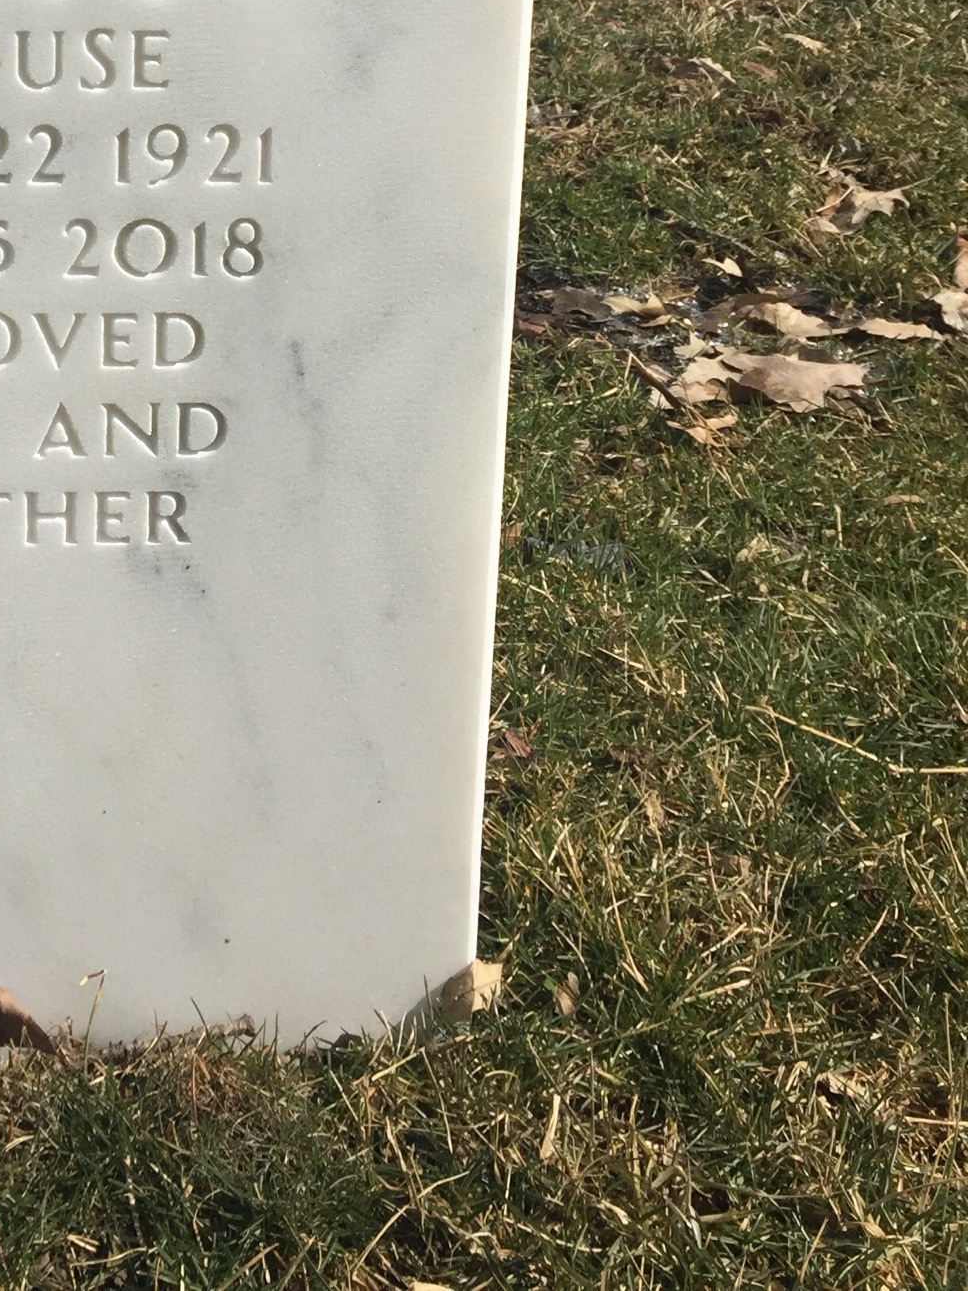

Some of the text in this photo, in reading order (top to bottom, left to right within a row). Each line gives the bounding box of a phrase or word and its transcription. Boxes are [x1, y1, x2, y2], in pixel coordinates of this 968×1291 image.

[114, 122, 274, 187] 1921
[63, 217, 264, 279] 2018
[33, 402, 229, 459] AND
